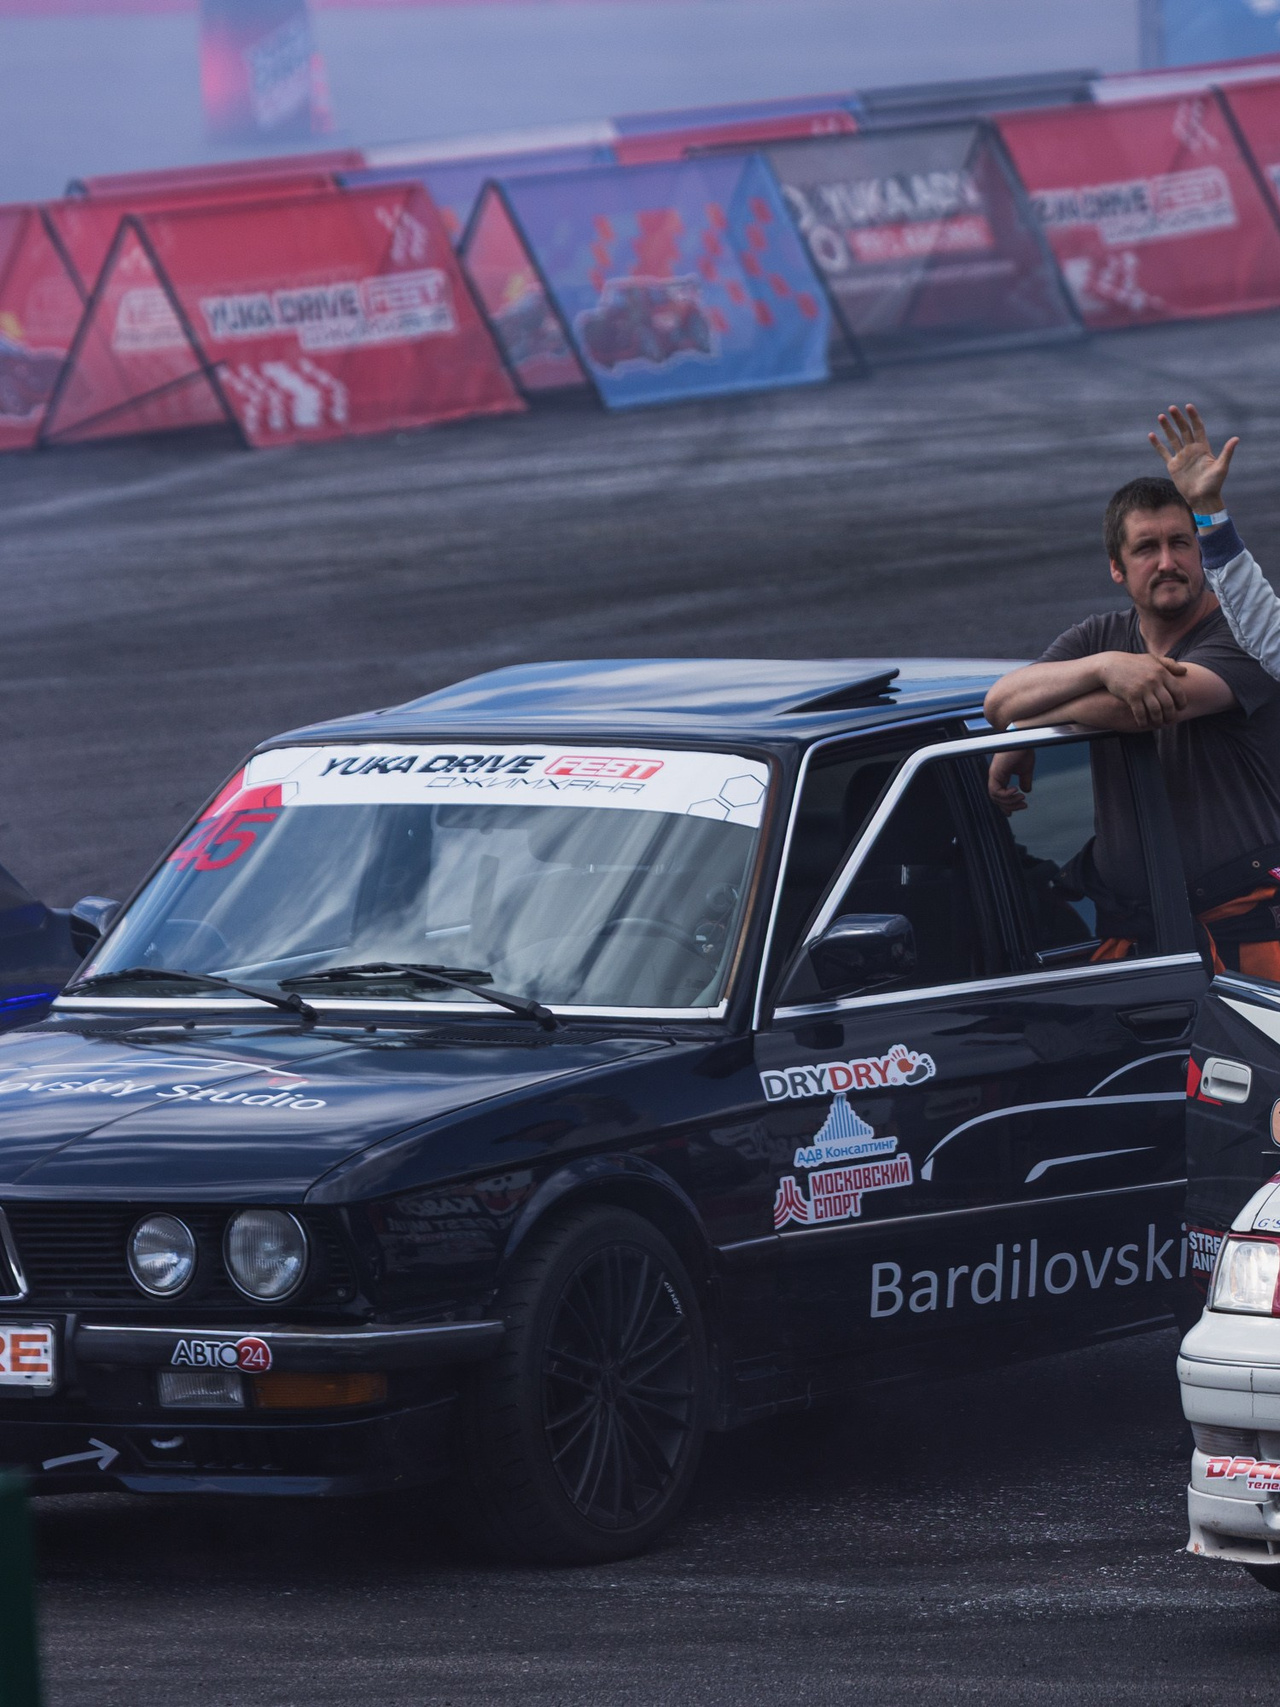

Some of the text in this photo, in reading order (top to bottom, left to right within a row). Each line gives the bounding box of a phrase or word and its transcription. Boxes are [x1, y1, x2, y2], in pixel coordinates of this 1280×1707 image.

[319, 754, 659, 779] YUKA DRIVE FEST
[424, 777, 647, 795] ДЖИМХАНА
[167, 813, 279, 872] 45
[763, 1059, 891, 1099] DRYDRY
[155, 1084, 327, 1110] Studio
[797, 1140, 895, 1164] АДВ Консалтинг
[811, 1156, 911, 1197] МОСКОВСКИЙ
[814, 1192, 860, 1219] СПОРТ
